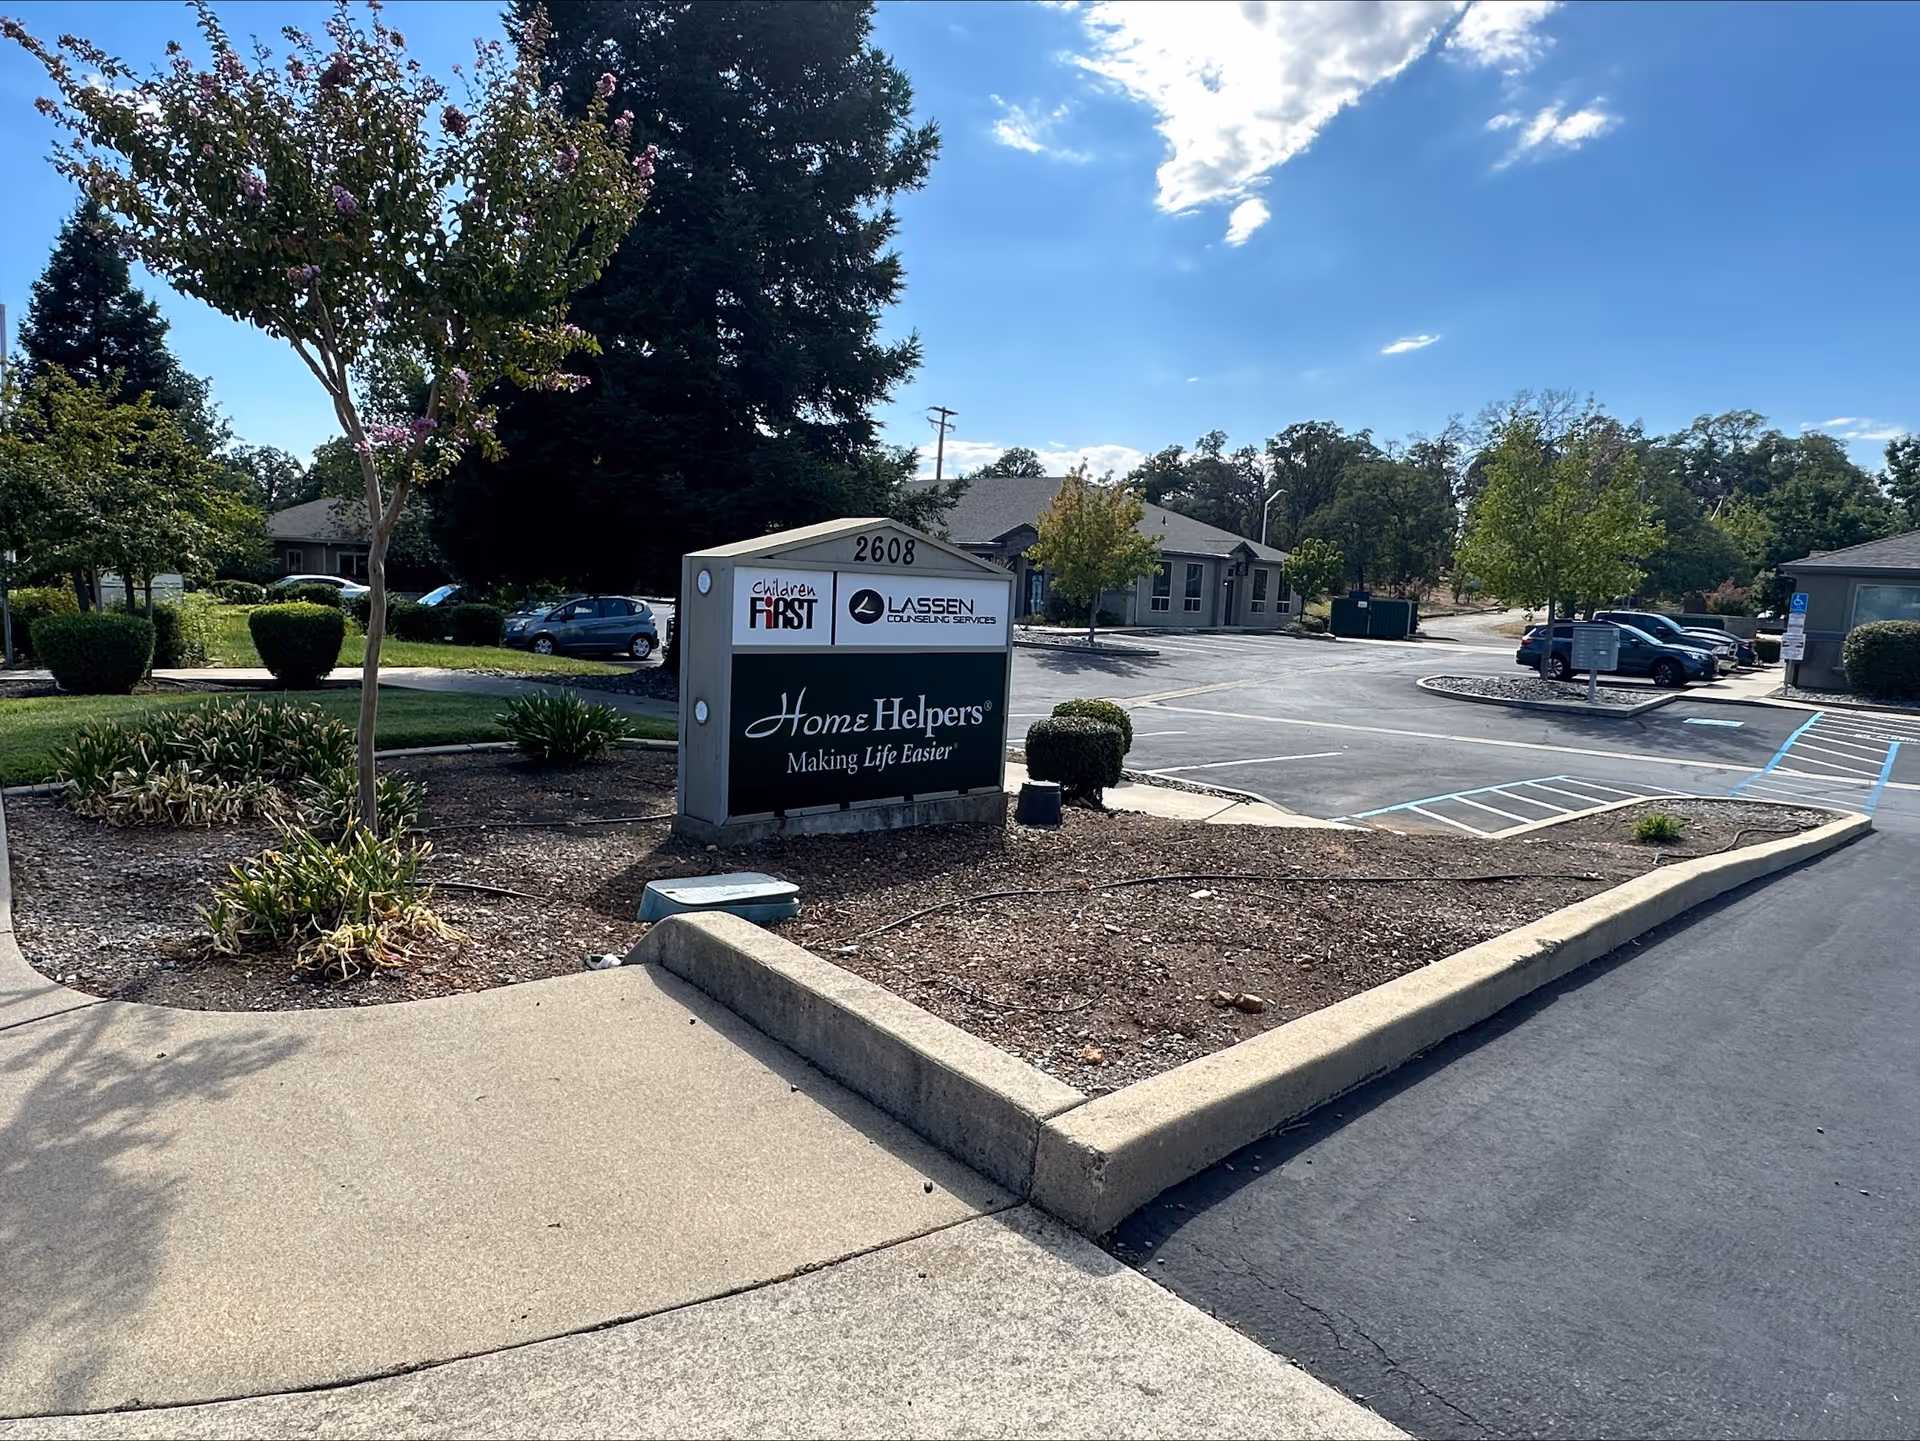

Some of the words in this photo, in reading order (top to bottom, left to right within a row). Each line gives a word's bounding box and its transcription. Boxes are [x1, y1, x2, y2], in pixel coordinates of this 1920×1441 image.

[853, 535, 917, 565] 2608
[752, 578, 817, 597] Children
[887, 596, 974, 615] LASSEN
[886, 614, 950, 624] COUNSELING
[952, 615, 997, 625] SERVICES
[744, 686, 870, 739] Home
[786, 749, 858, 775] Making
[863, 743, 898, 772] Life
